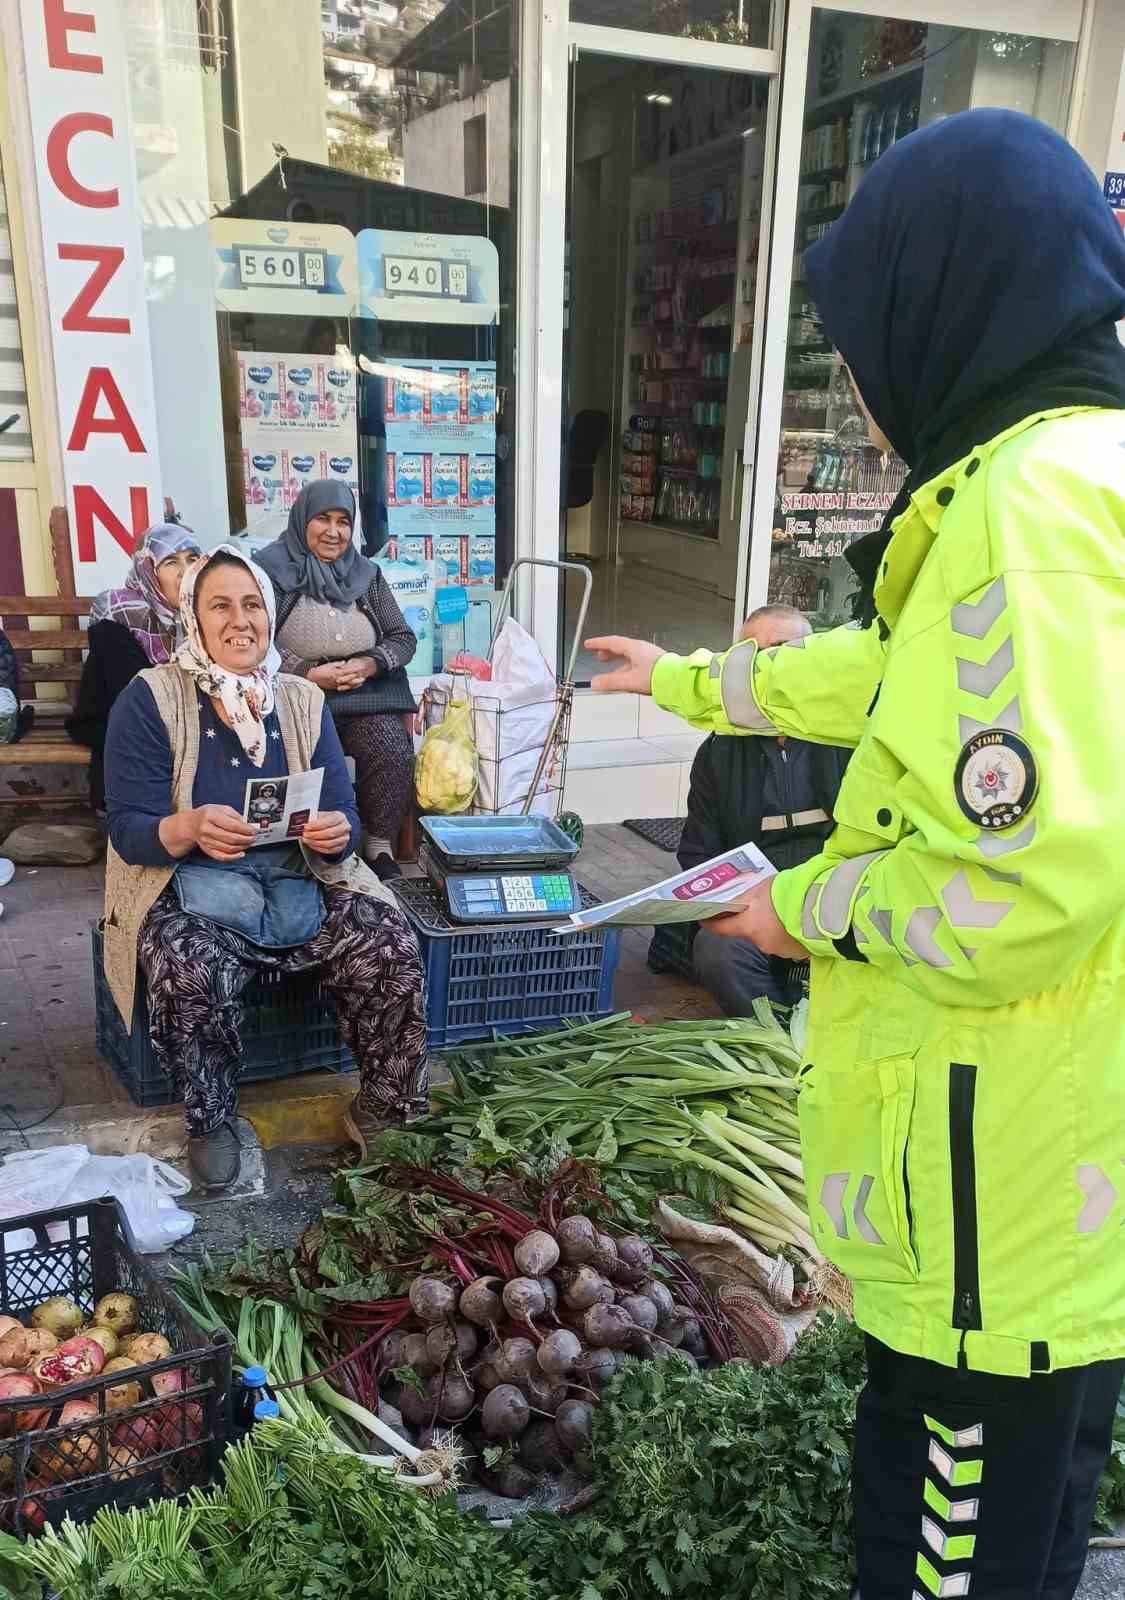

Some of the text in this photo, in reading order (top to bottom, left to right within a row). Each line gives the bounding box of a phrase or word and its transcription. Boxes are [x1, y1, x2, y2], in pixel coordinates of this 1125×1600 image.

[1109, 178, 1125, 194] 33
[245, 255, 295, 277] 560
[390, 265, 437, 286] 940
[43, 0, 150, 563] ECZAN
[847, 492, 898, 510] ECZAN
[970, 734, 1004, 755] AYDIN
